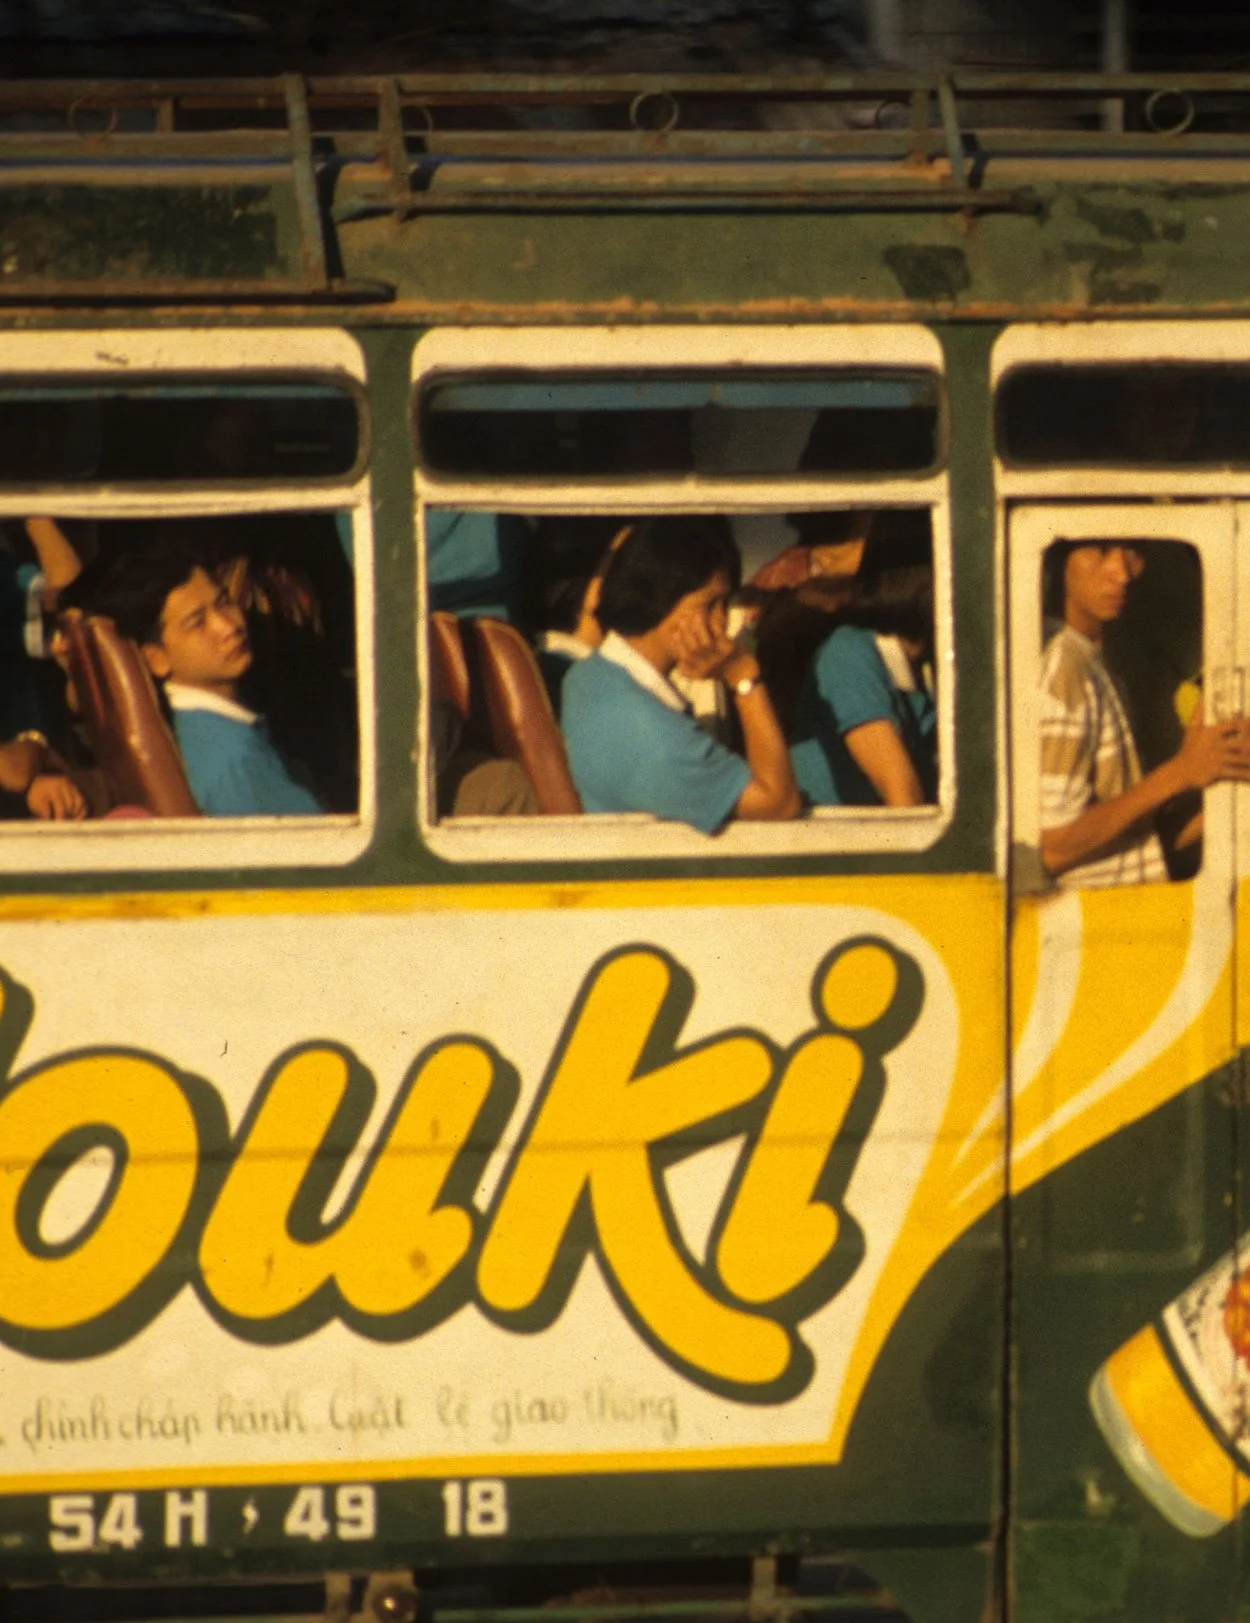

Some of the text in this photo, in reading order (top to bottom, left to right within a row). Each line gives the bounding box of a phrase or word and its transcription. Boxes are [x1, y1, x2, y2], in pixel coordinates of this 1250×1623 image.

[0, 934, 925, 1406] ouki
[48, 1492, 143, 1554] 54
[284, 1484, 376, 1541] 49
[442, 1478, 508, 1538] 18
